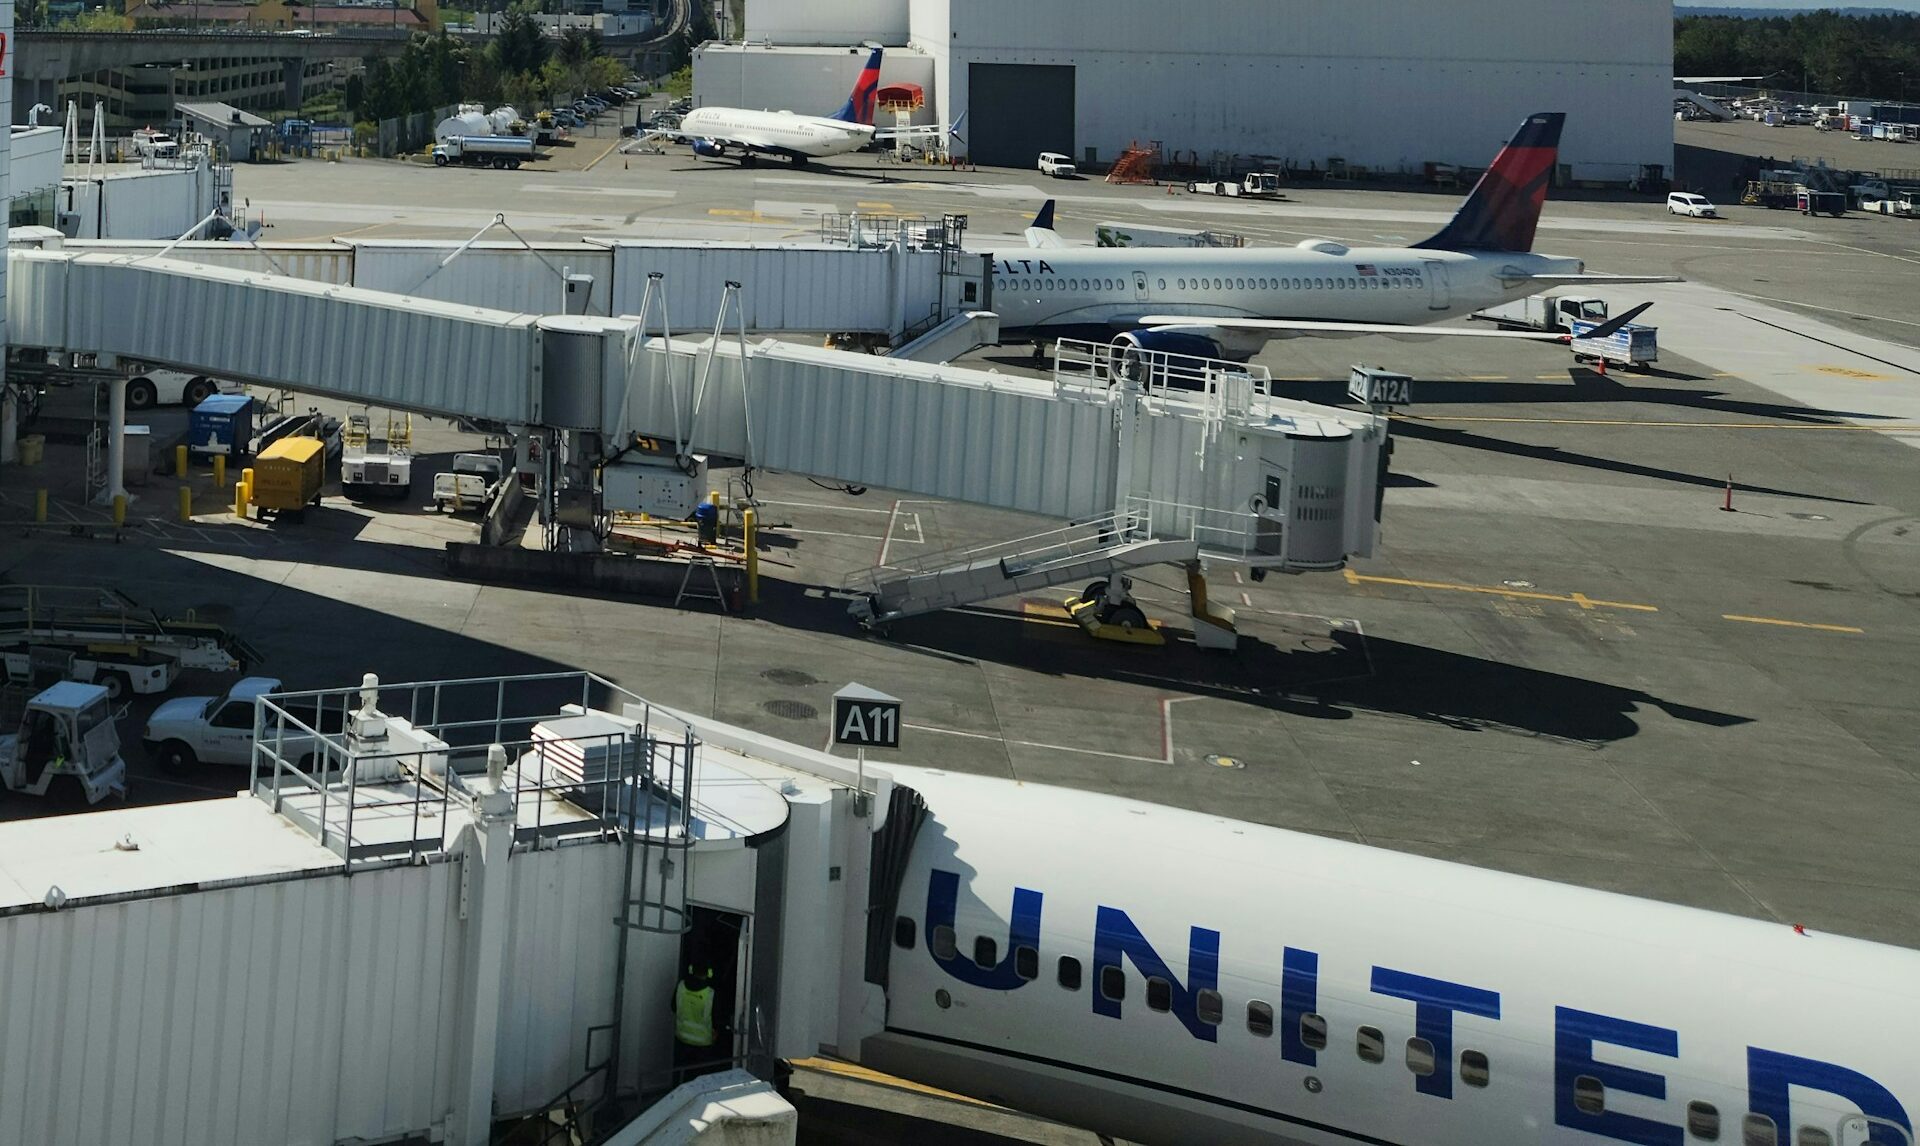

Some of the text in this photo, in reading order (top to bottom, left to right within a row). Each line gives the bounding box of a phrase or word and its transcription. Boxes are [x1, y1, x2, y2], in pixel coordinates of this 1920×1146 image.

[1371, 379, 1410, 402] A12A
[841, 705, 896, 743] A11
[924, 868, 1915, 1146] UNITED
